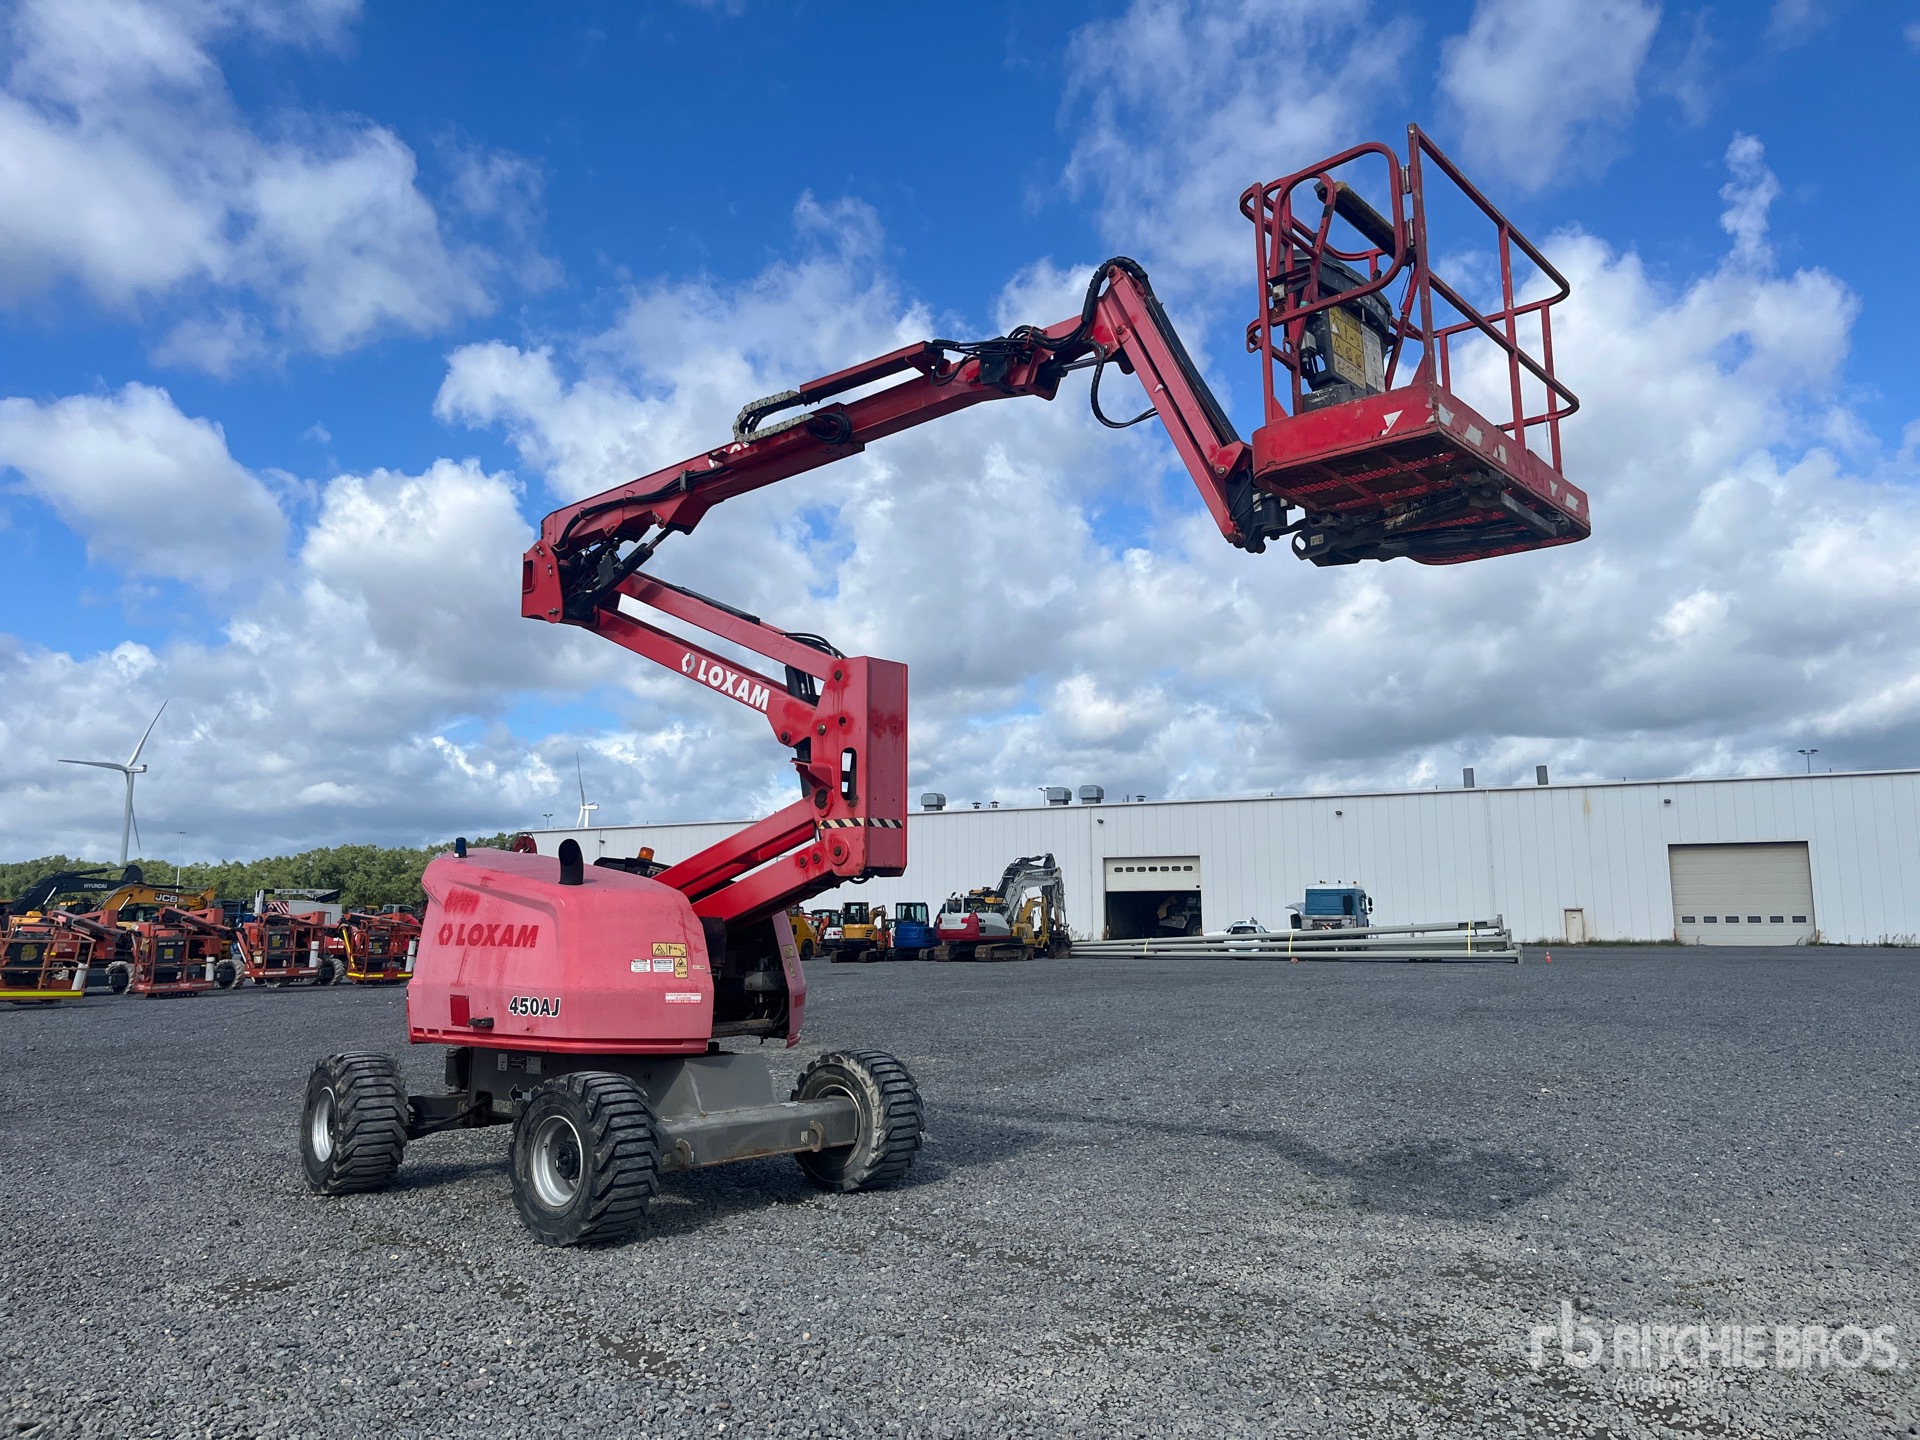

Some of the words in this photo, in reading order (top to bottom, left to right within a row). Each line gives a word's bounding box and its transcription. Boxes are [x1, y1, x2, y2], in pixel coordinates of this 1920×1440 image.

[697, 659, 770, 711] LOXAM
[155, 893, 178, 902] JCB
[456, 923, 539, 948] LOXAM
[508, 997, 561, 1017] 450AJ
